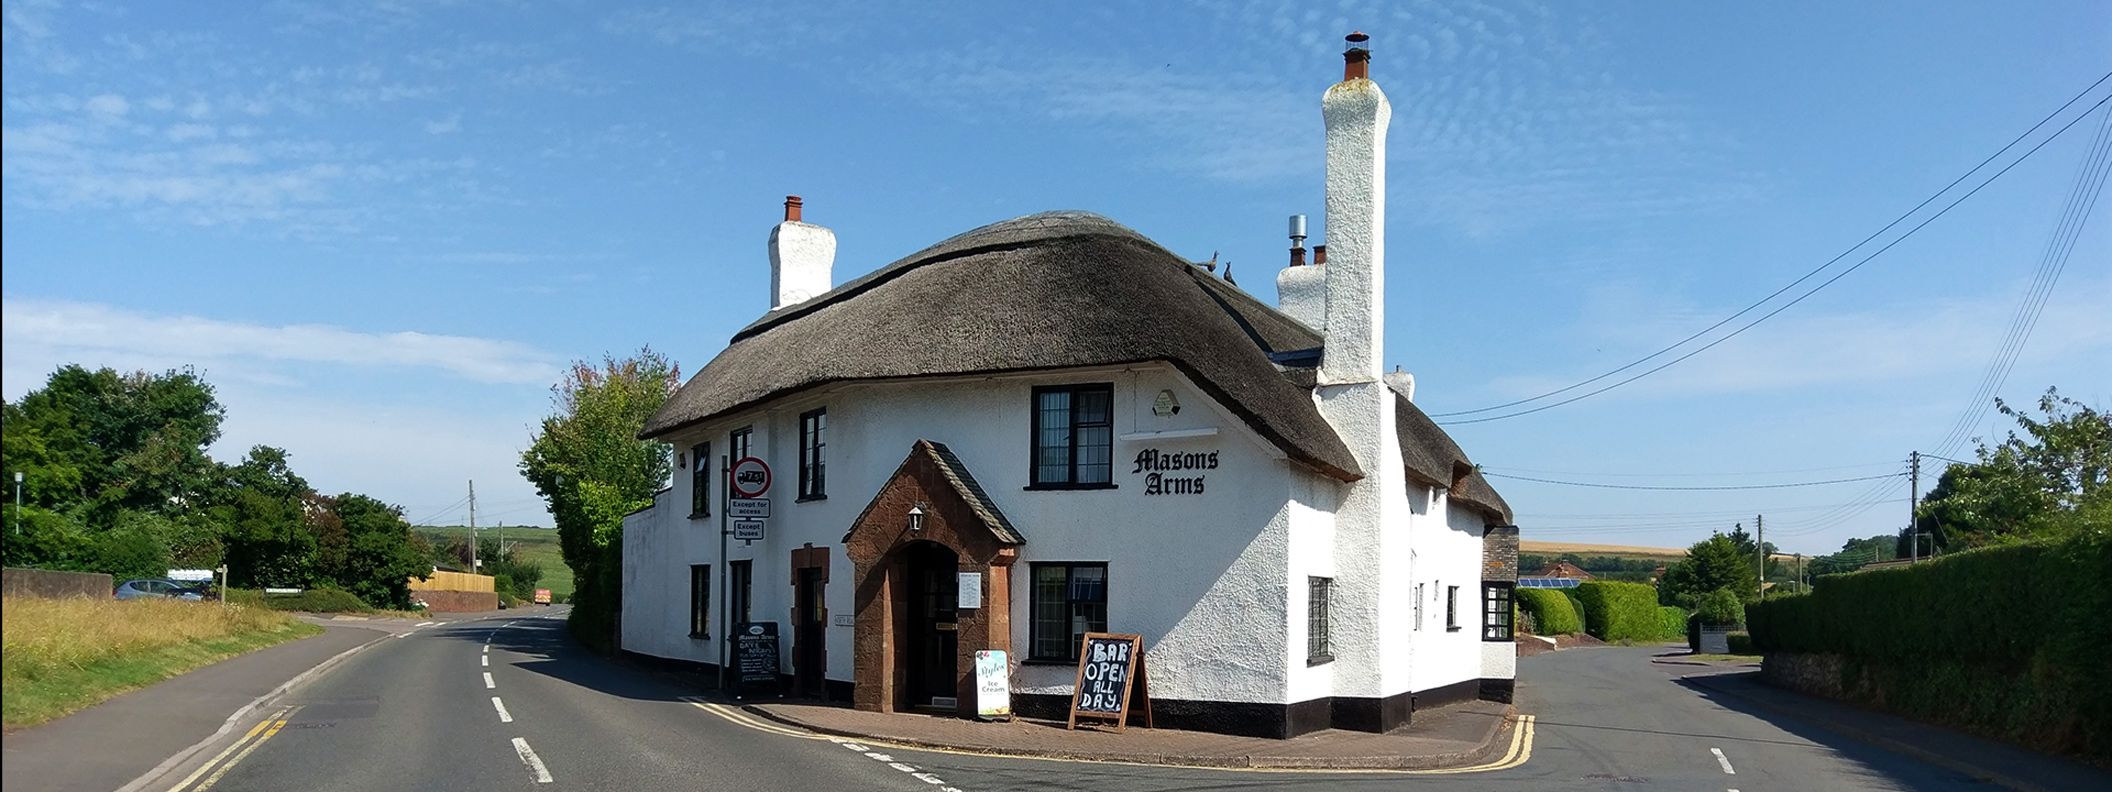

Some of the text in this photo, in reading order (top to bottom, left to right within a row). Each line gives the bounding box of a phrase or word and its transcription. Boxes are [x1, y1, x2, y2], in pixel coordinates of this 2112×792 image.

[1132, 448, 1220, 474] Masons
[1144, 472, 1206, 496] Arms
[1092, 643, 1128, 662] BAR
[1086, 661, 1127, 682] OPEN
[1093, 681, 1114, 694] ALL
[1081, 693, 1117, 709] DAY
